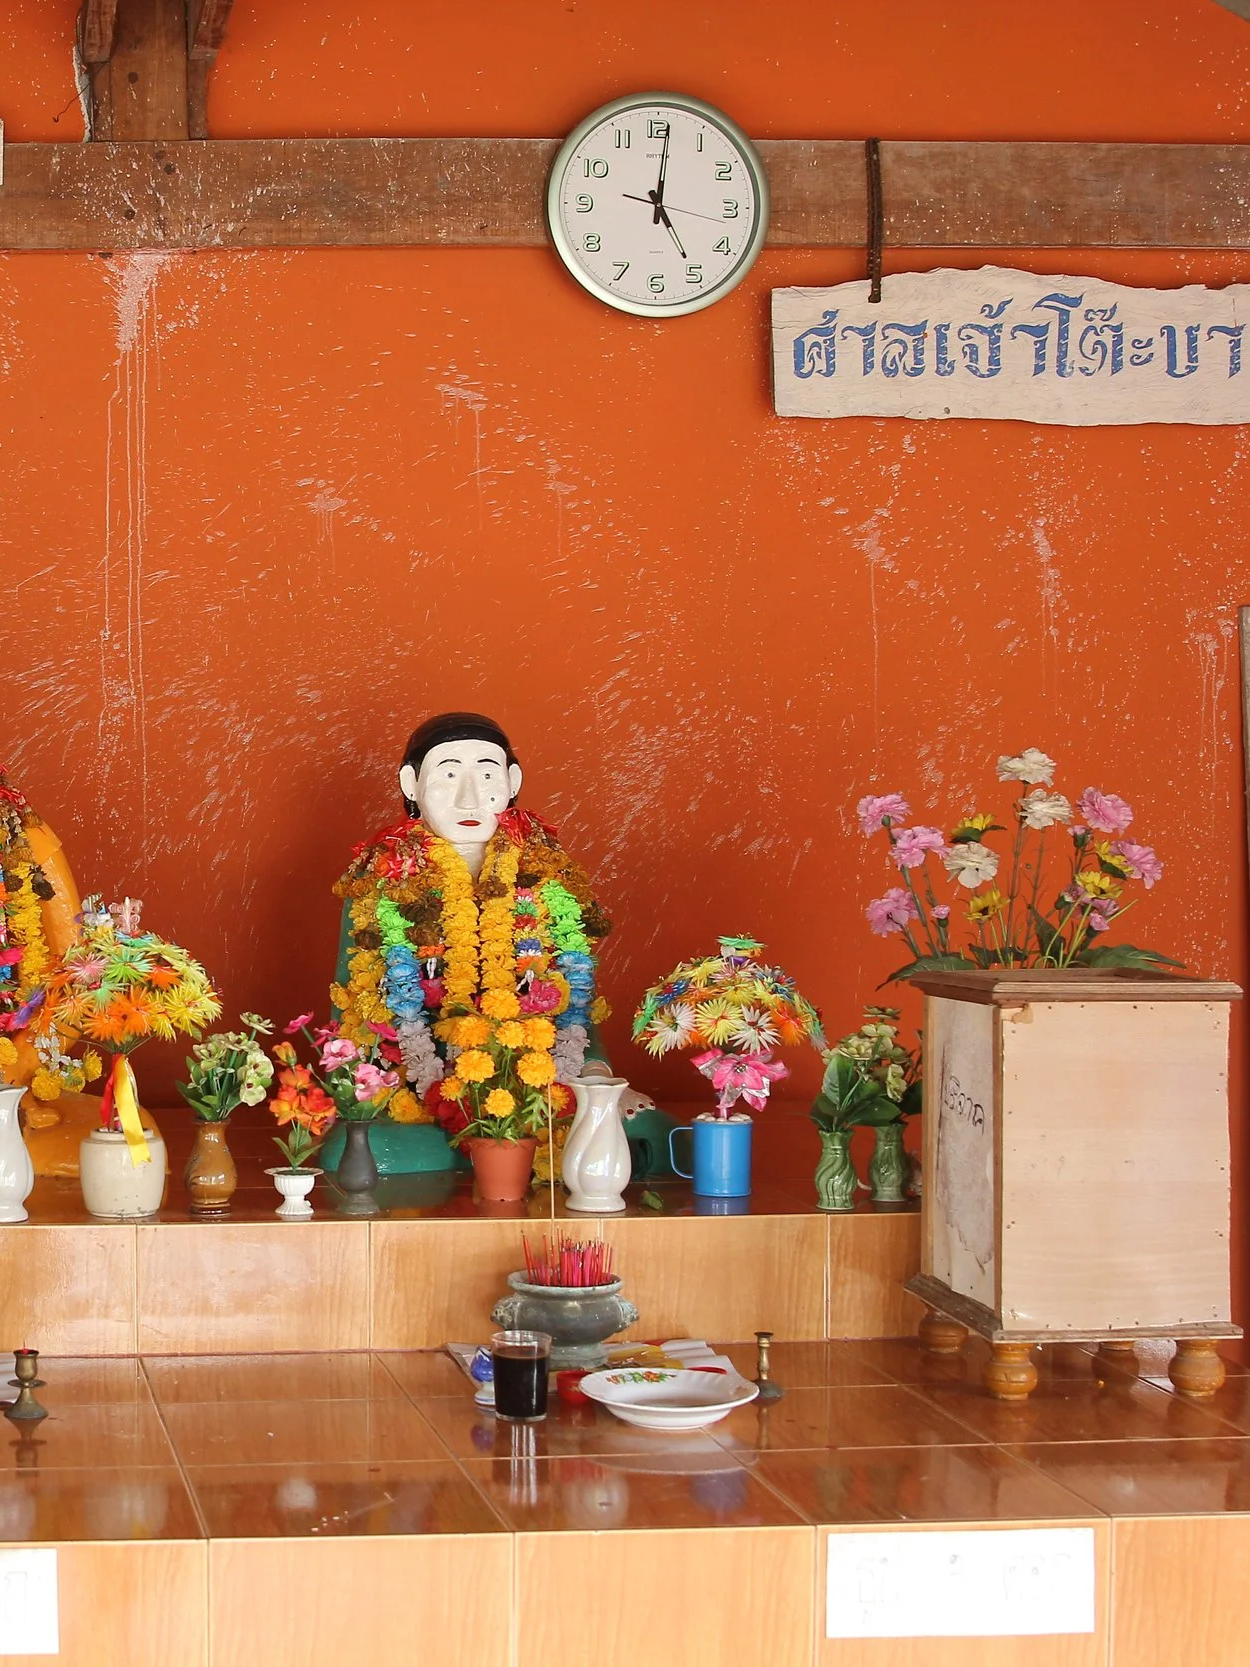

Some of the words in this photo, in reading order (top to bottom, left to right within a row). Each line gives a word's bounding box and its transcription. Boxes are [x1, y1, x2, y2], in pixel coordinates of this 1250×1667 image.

[646, 119, 670, 139] 12
[615, 130, 631, 149] 11
[696, 133, 703, 152] 1
[583, 158, 609, 178] 10
[714, 161, 732, 181] 2
[575, 193, 594, 213] 9
[722, 199, 739, 218] 3
[583, 233, 601, 252] 8
[712, 235, 731, 255] 4
[612, 261, 630, 281] 7
[685, 264, 703, 283] 5
[646, 274, 665, 293] 6
